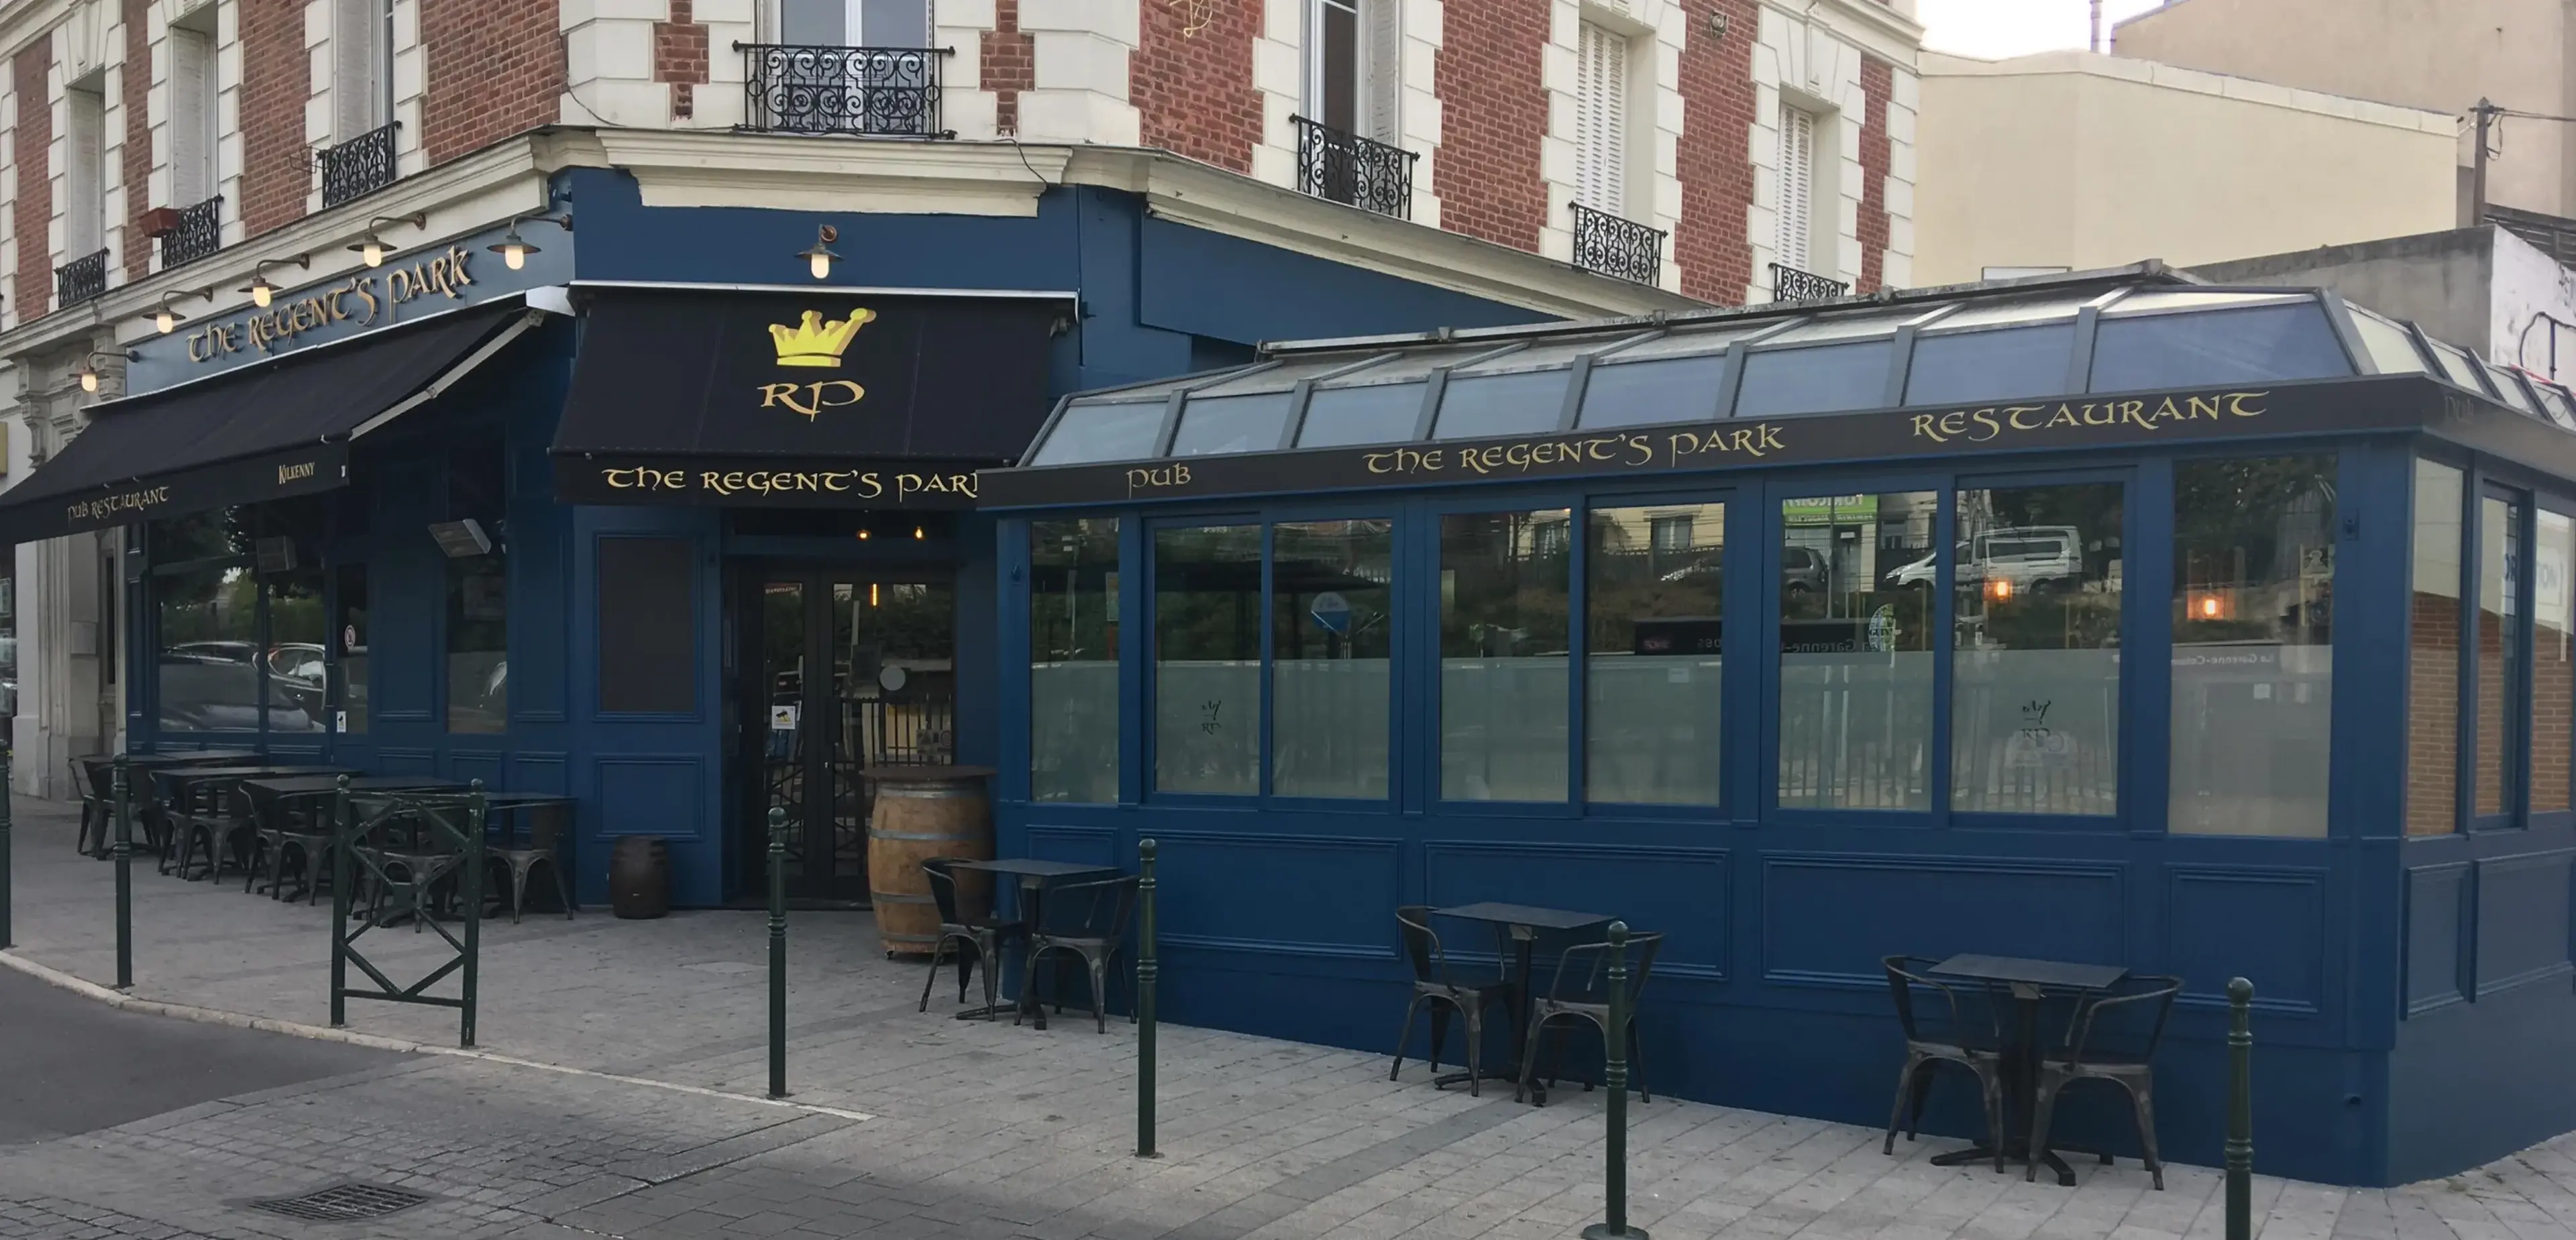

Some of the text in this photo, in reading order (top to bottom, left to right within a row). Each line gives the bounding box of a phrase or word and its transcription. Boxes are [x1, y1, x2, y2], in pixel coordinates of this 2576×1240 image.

[186, 244, 472, 363] THE REGENT'S PARK
[757, 380, 865, 422] RP
[1126, 390, 2270, 500] PUB THE REGENT'S PARK RESTAURANT
[91, 486, 170, 519] RESTAURANT
[601, 465, 686, 492] THE
[700, 469, 883, 498] REGENT'S
